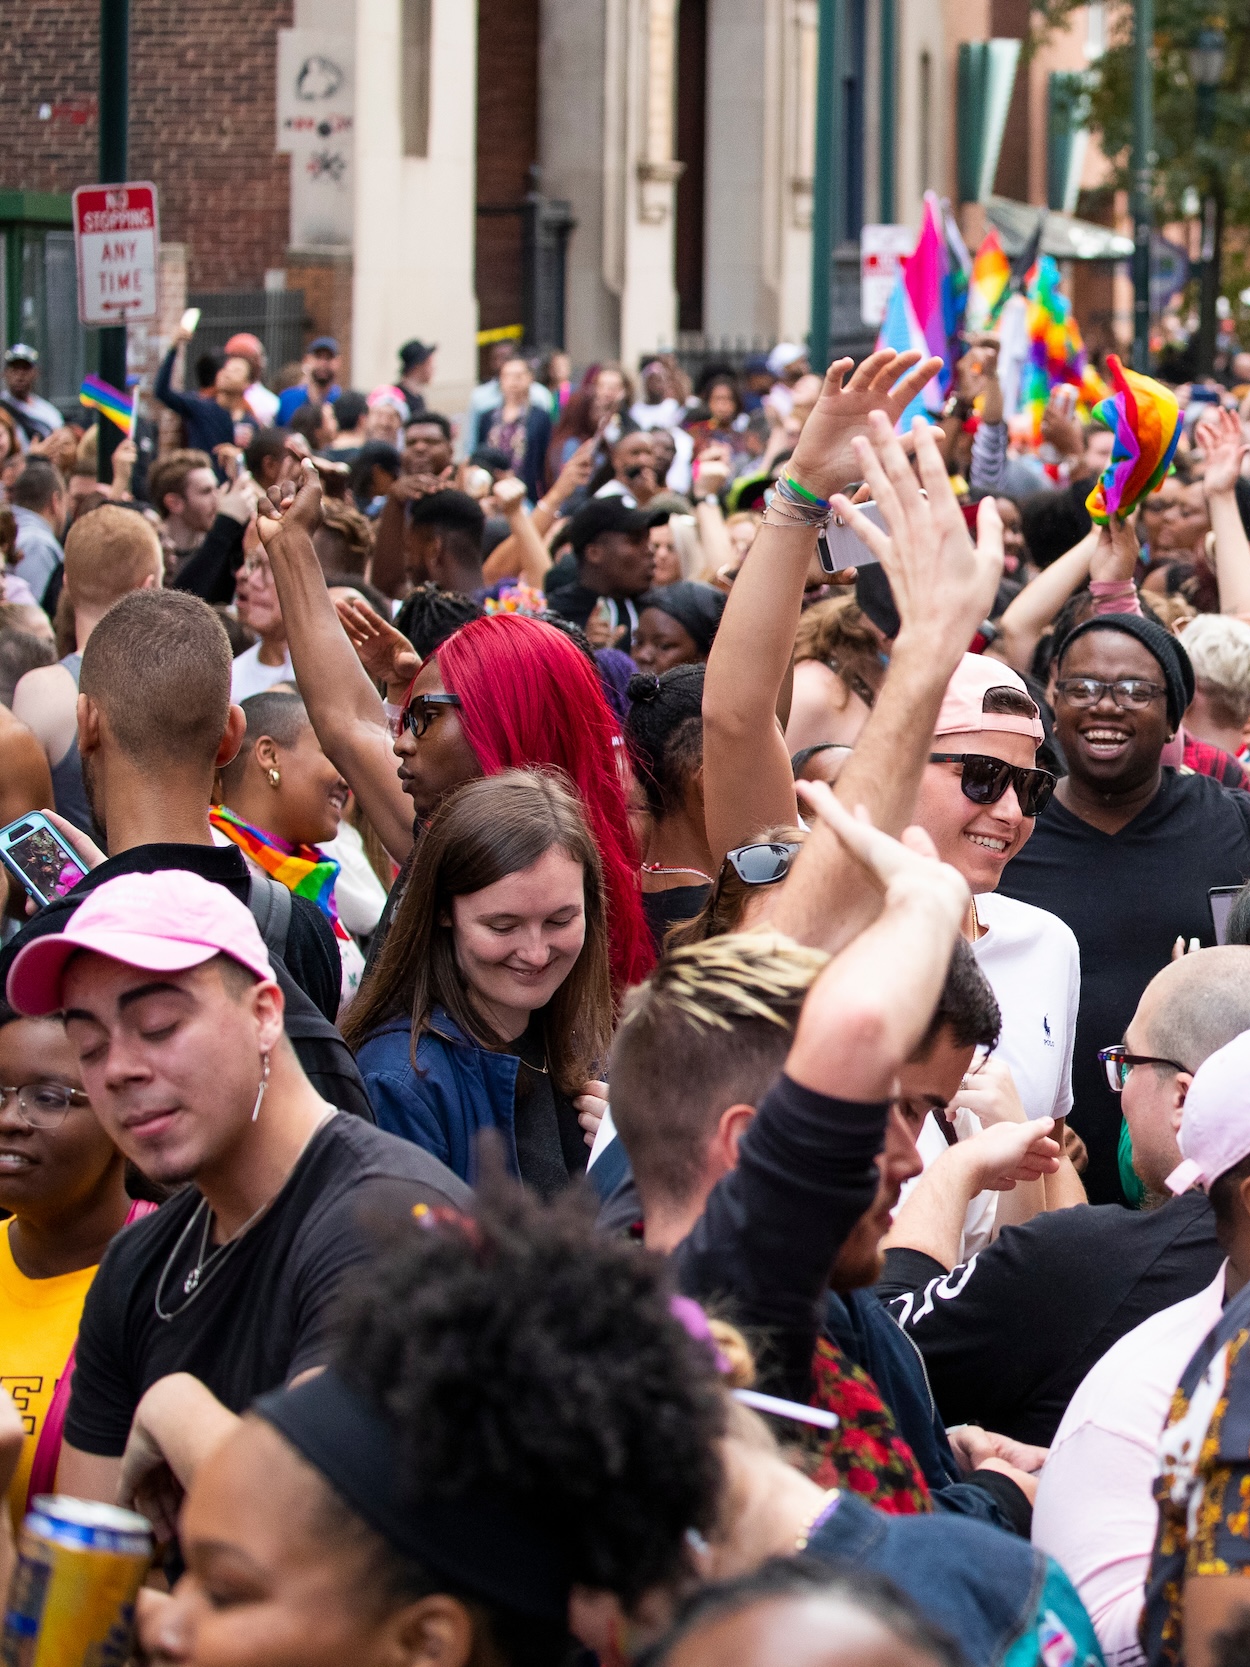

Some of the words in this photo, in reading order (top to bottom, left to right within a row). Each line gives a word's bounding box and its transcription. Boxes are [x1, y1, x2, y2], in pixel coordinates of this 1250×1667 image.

[104, 190, 130, 209] NO
[84, 206, 152, 233] STOPPING
[101, 240, 138, 263] ANY
[98, 267, 143, 296] TIME
